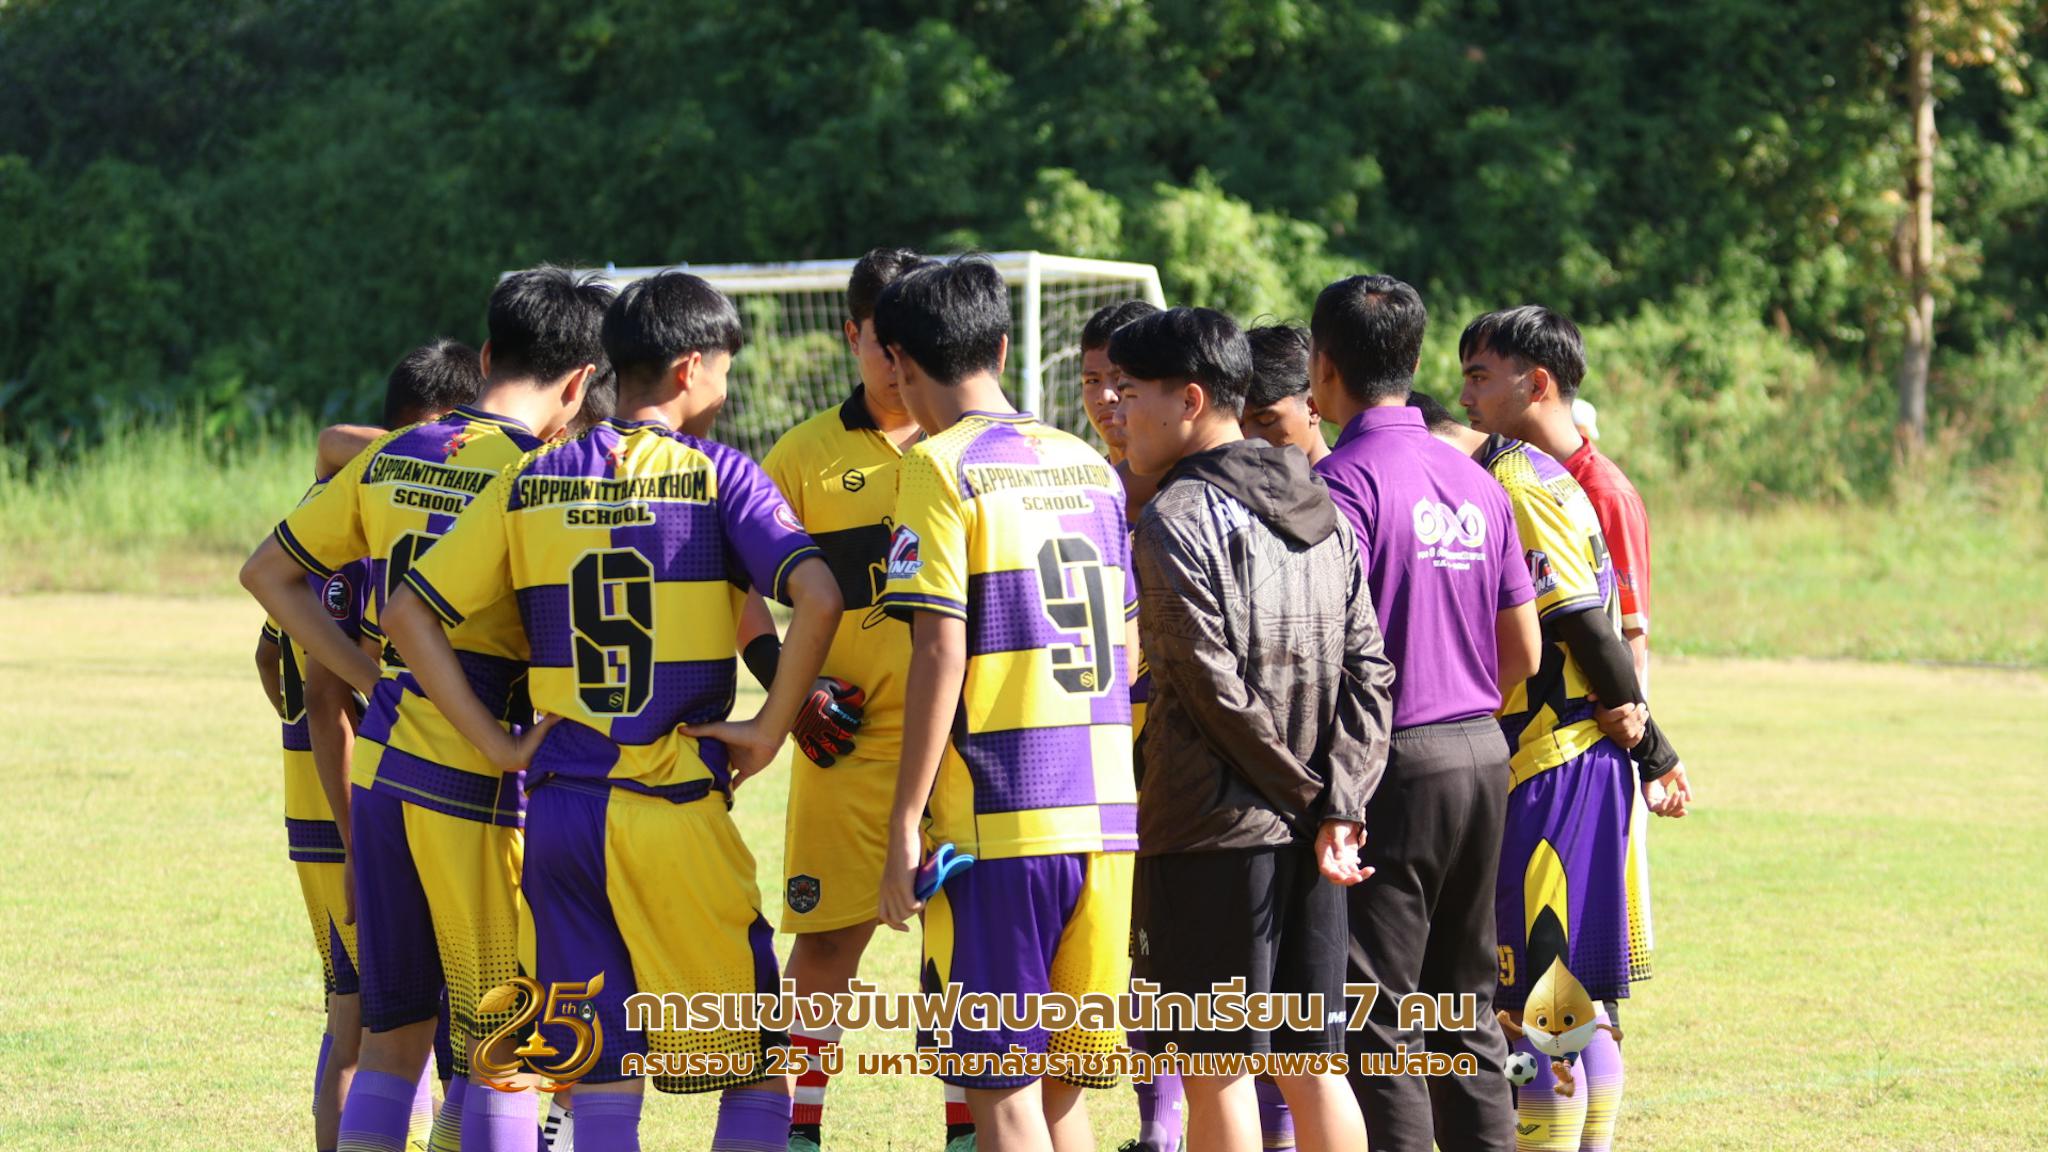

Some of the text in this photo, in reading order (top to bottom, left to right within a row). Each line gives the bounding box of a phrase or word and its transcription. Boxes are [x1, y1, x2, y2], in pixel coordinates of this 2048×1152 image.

[393, 488, 464, 514] SCHOOL
[520, 470, 707, 507] SAPPHAWITTHAYAKHOM
[567, 506, 651, 525] SCHOOL
[1022, 495, 1090, 511] SCHOOL
[1036, 535, 1114, 695] 9
